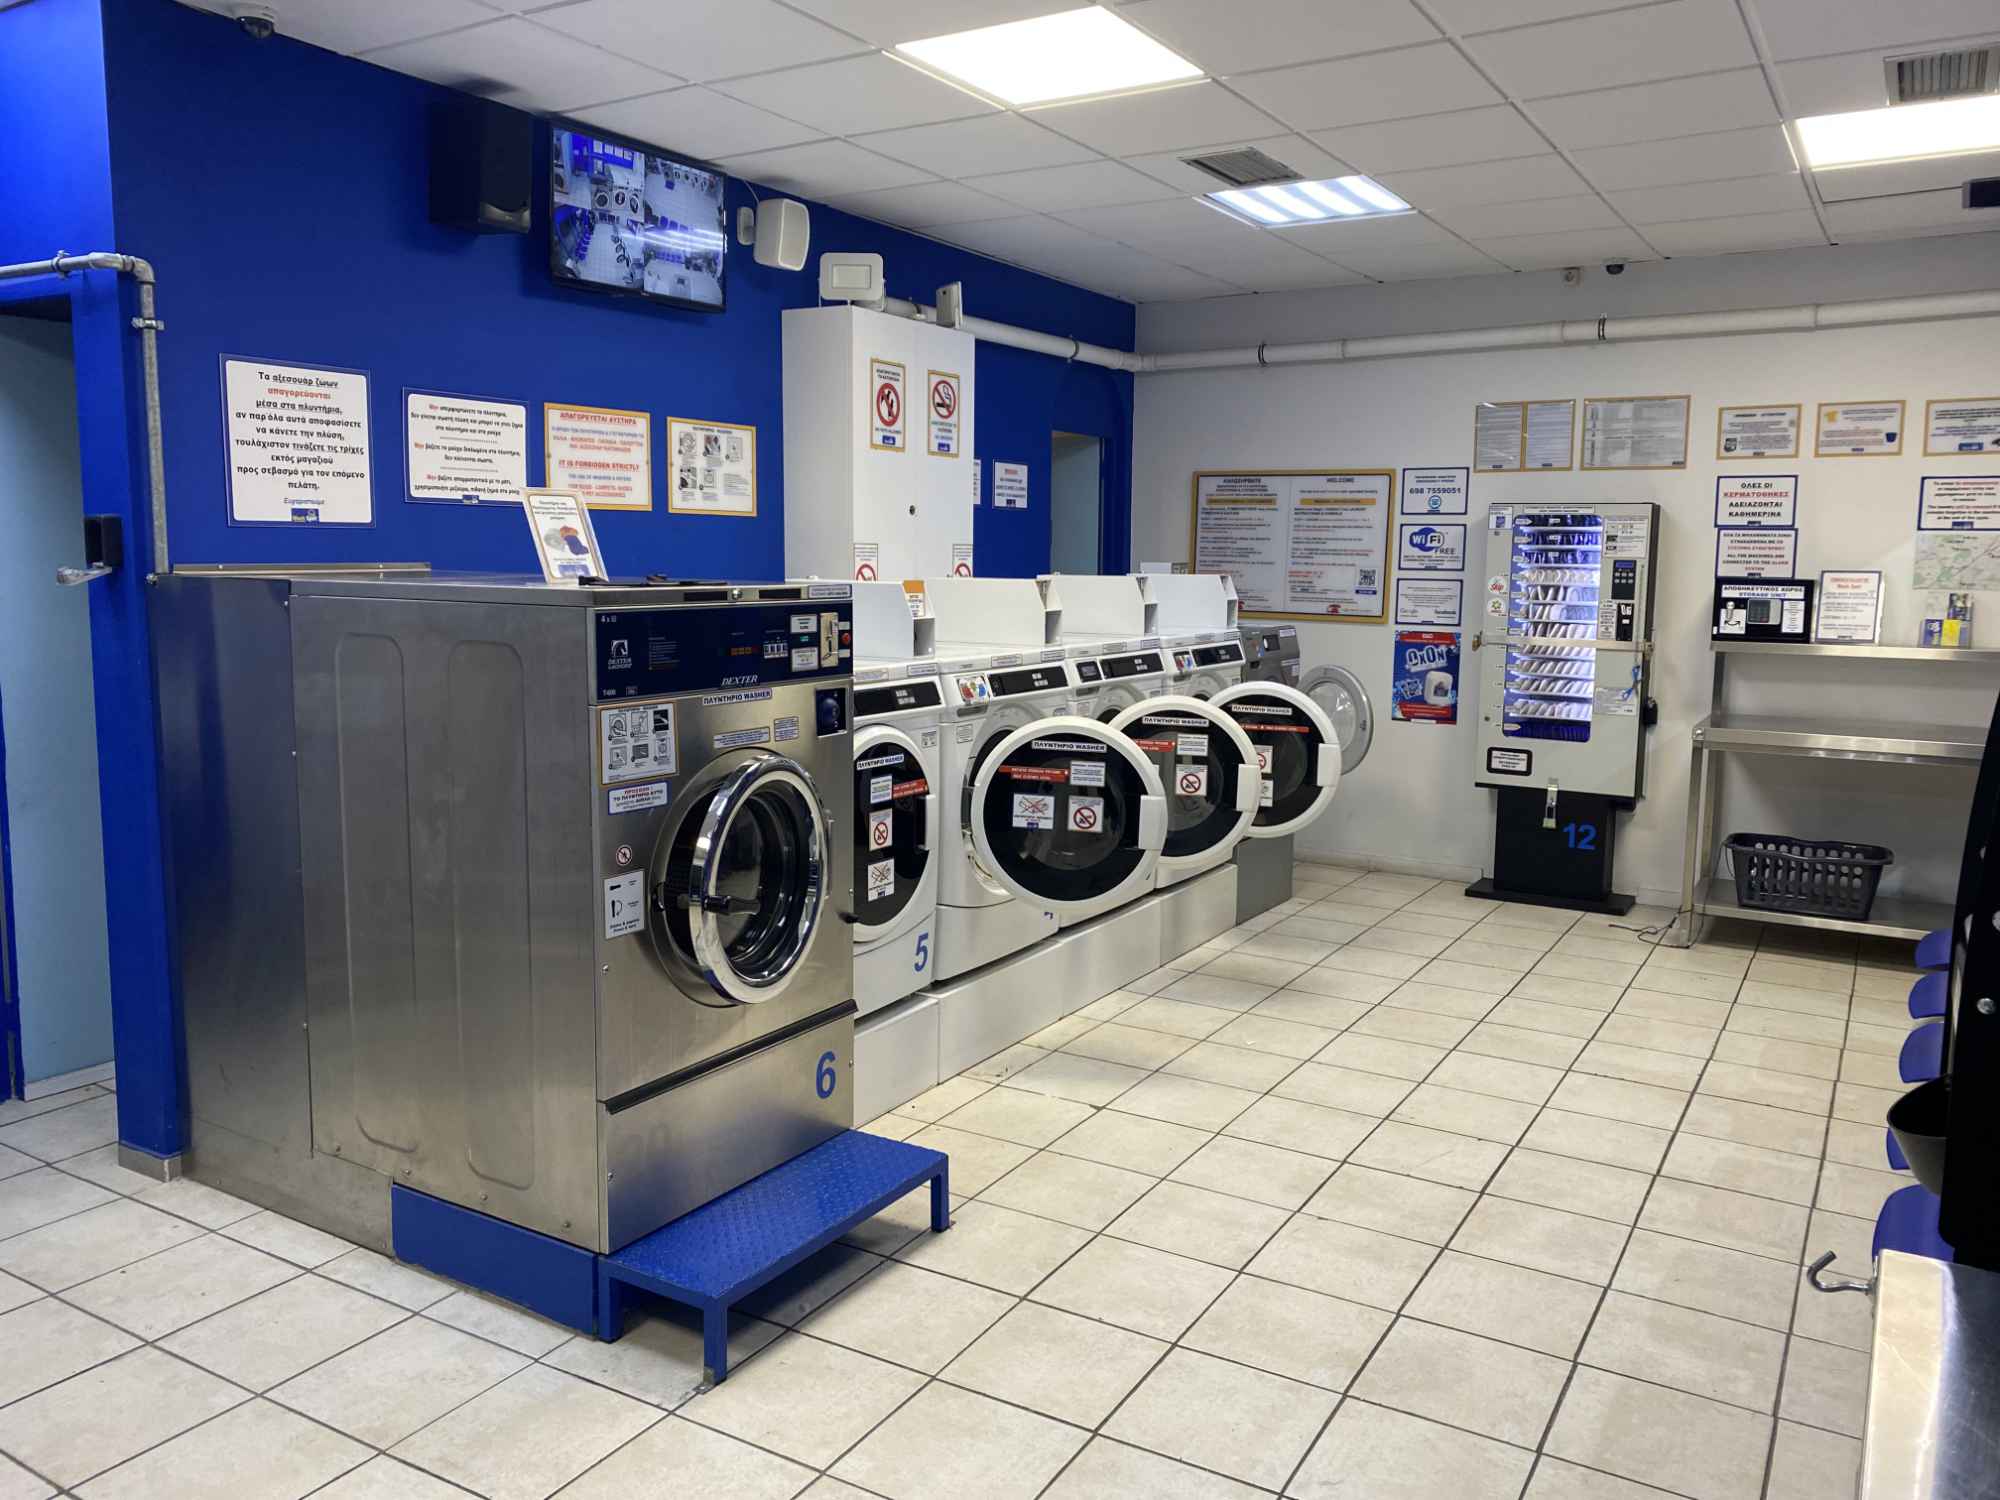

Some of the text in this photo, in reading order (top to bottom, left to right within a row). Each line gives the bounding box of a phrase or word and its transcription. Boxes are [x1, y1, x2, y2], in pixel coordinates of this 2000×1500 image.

[258, 371, 270, 382] Τα
[256, 400, 278, 409] μέσα
[280, 402, 296, 410] στα
[308, 417, 361, 428] αποφασίσετε
[269, 427, 298, 436] κάνετε
[300, 430, 314, 439] την
[235, 439, 290, 449] τουλάχιστον
[327, 445, 337, 453] τις
[271, 454, 333, 466] εκτός μαγαζιού
[575, 460, 611, 469] FORBIDDEN
[612, 462, 640, 471] STRICTLY
[237, 466, 259, 475] προς
[261, 467, 299, 477] σεβασμό
[300, 469, 314, 478] για
[331, 471, 365, 480] επόμενο
[721, 674, 758, 686] DEXTER
[703, 690, 771, 705] ΠΛΥΝΤΗΡΙΟ WASHER
[1232, 704, 1265, 713] ΠΛΥΝΤΗΡΙΟ
[1144, 716, 1208, 726] ΠΛΥΝΤΗΡΙΟ WASHER
[1034, 741, 1105, 752] ΠΛΥΝΤΗΡΙΟ WASHER
[1562, 823, 1597, 849] 12
[914, 932, 929, 972] 5
[815, 1050, 836, 1100] 6
